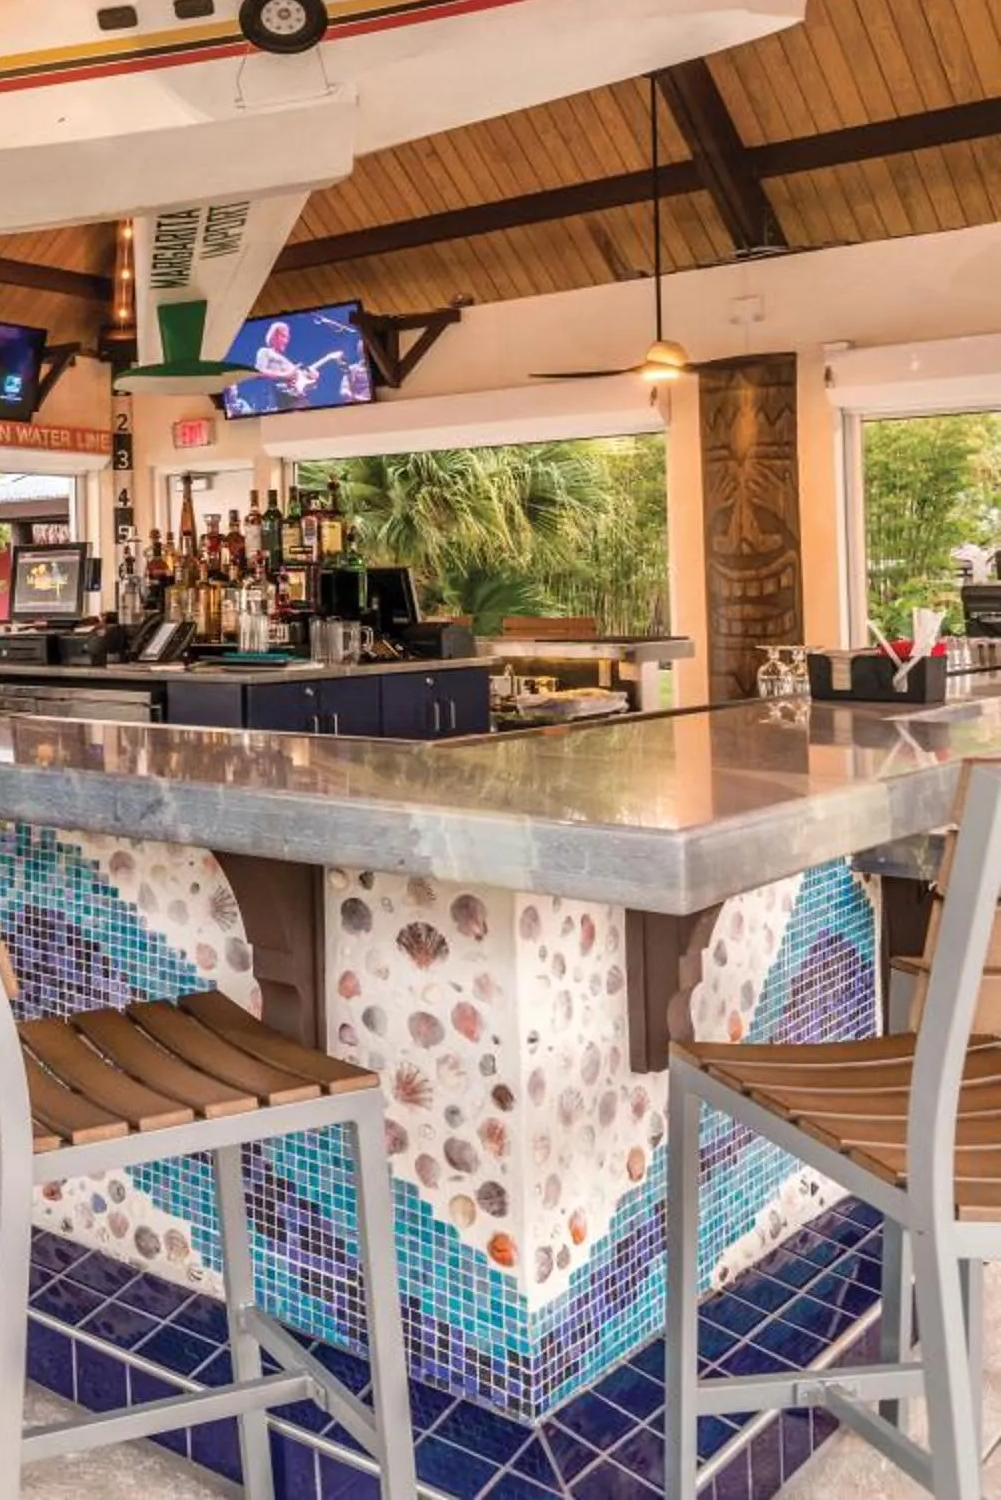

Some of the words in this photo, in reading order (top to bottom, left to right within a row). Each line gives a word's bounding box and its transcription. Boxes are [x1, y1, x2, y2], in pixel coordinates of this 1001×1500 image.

[117, 413, 128, 432] 2
[16, 426, 71, 446] WATER
[76, 430, 111, 451] LINE
[117, 450, 129, 470] 3
[118, 488, 130, 508] 4
